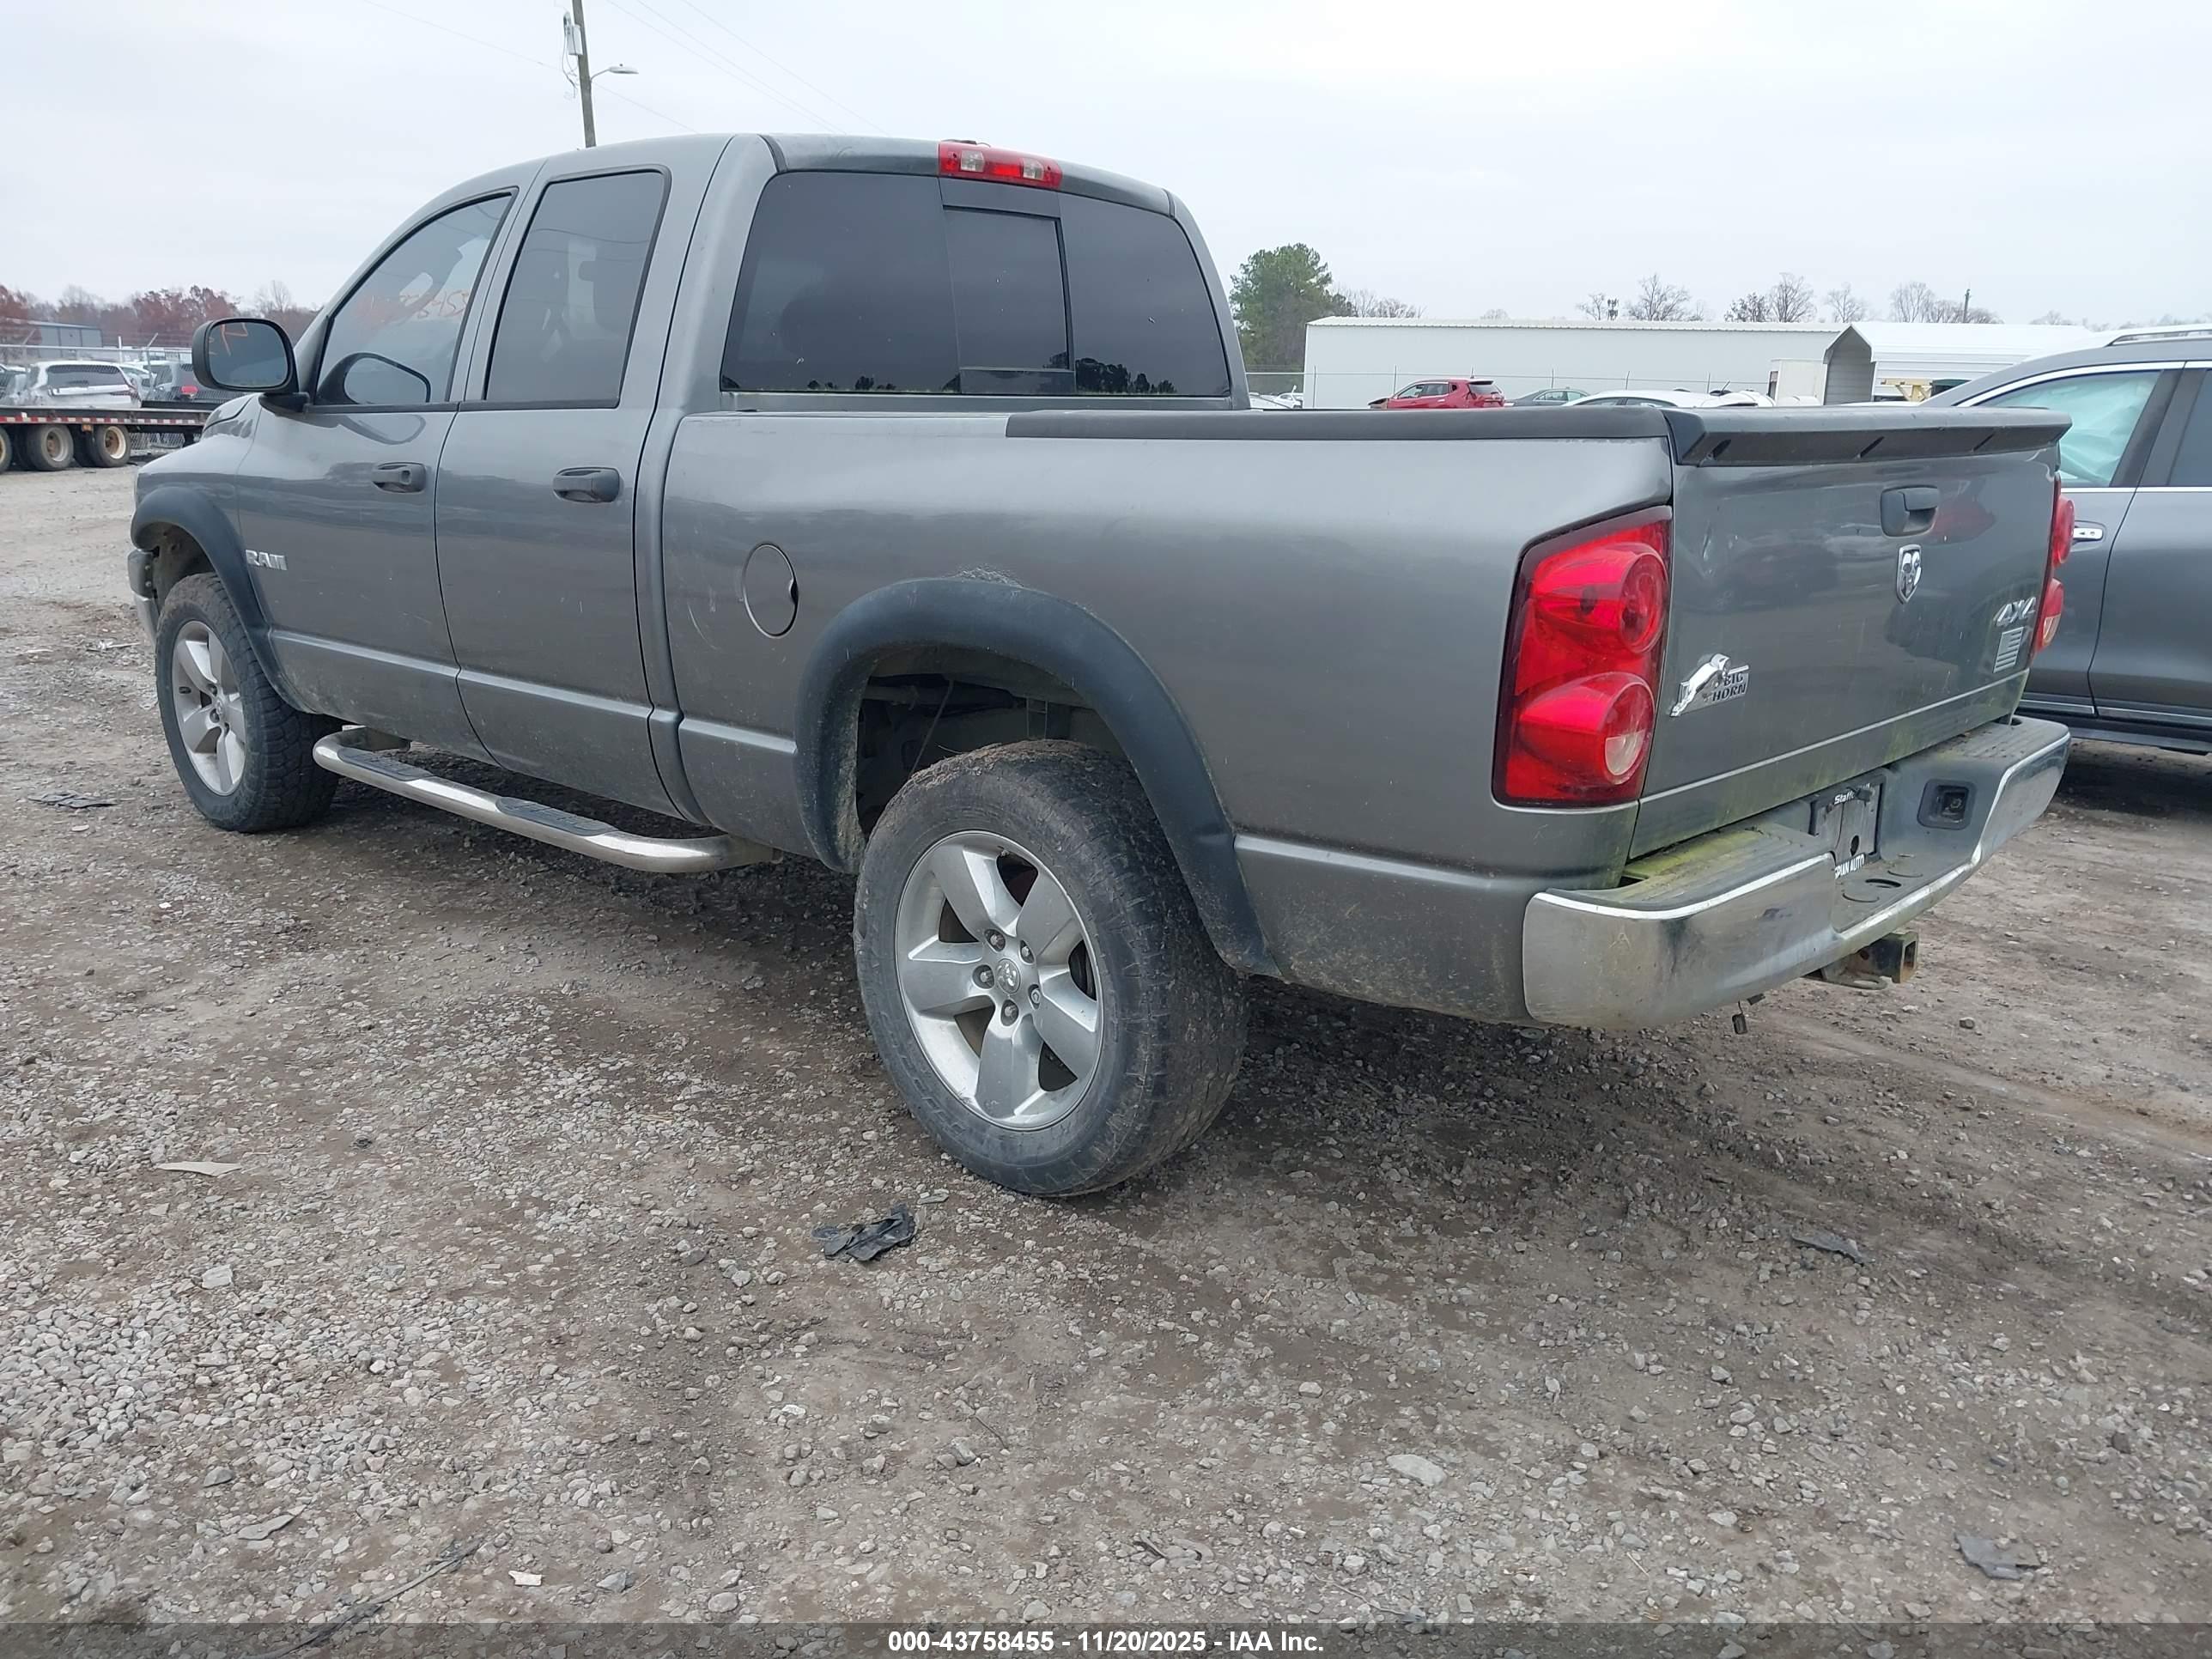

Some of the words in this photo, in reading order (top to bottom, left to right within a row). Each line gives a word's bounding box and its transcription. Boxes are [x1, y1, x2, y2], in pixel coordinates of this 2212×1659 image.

[246, 550, 287, 570] RAM
[1723, 672, 1744, 686] BIG
[1712, 684, 1746, 702] HORN
[1850, 854, 1865, 872] AUTO
